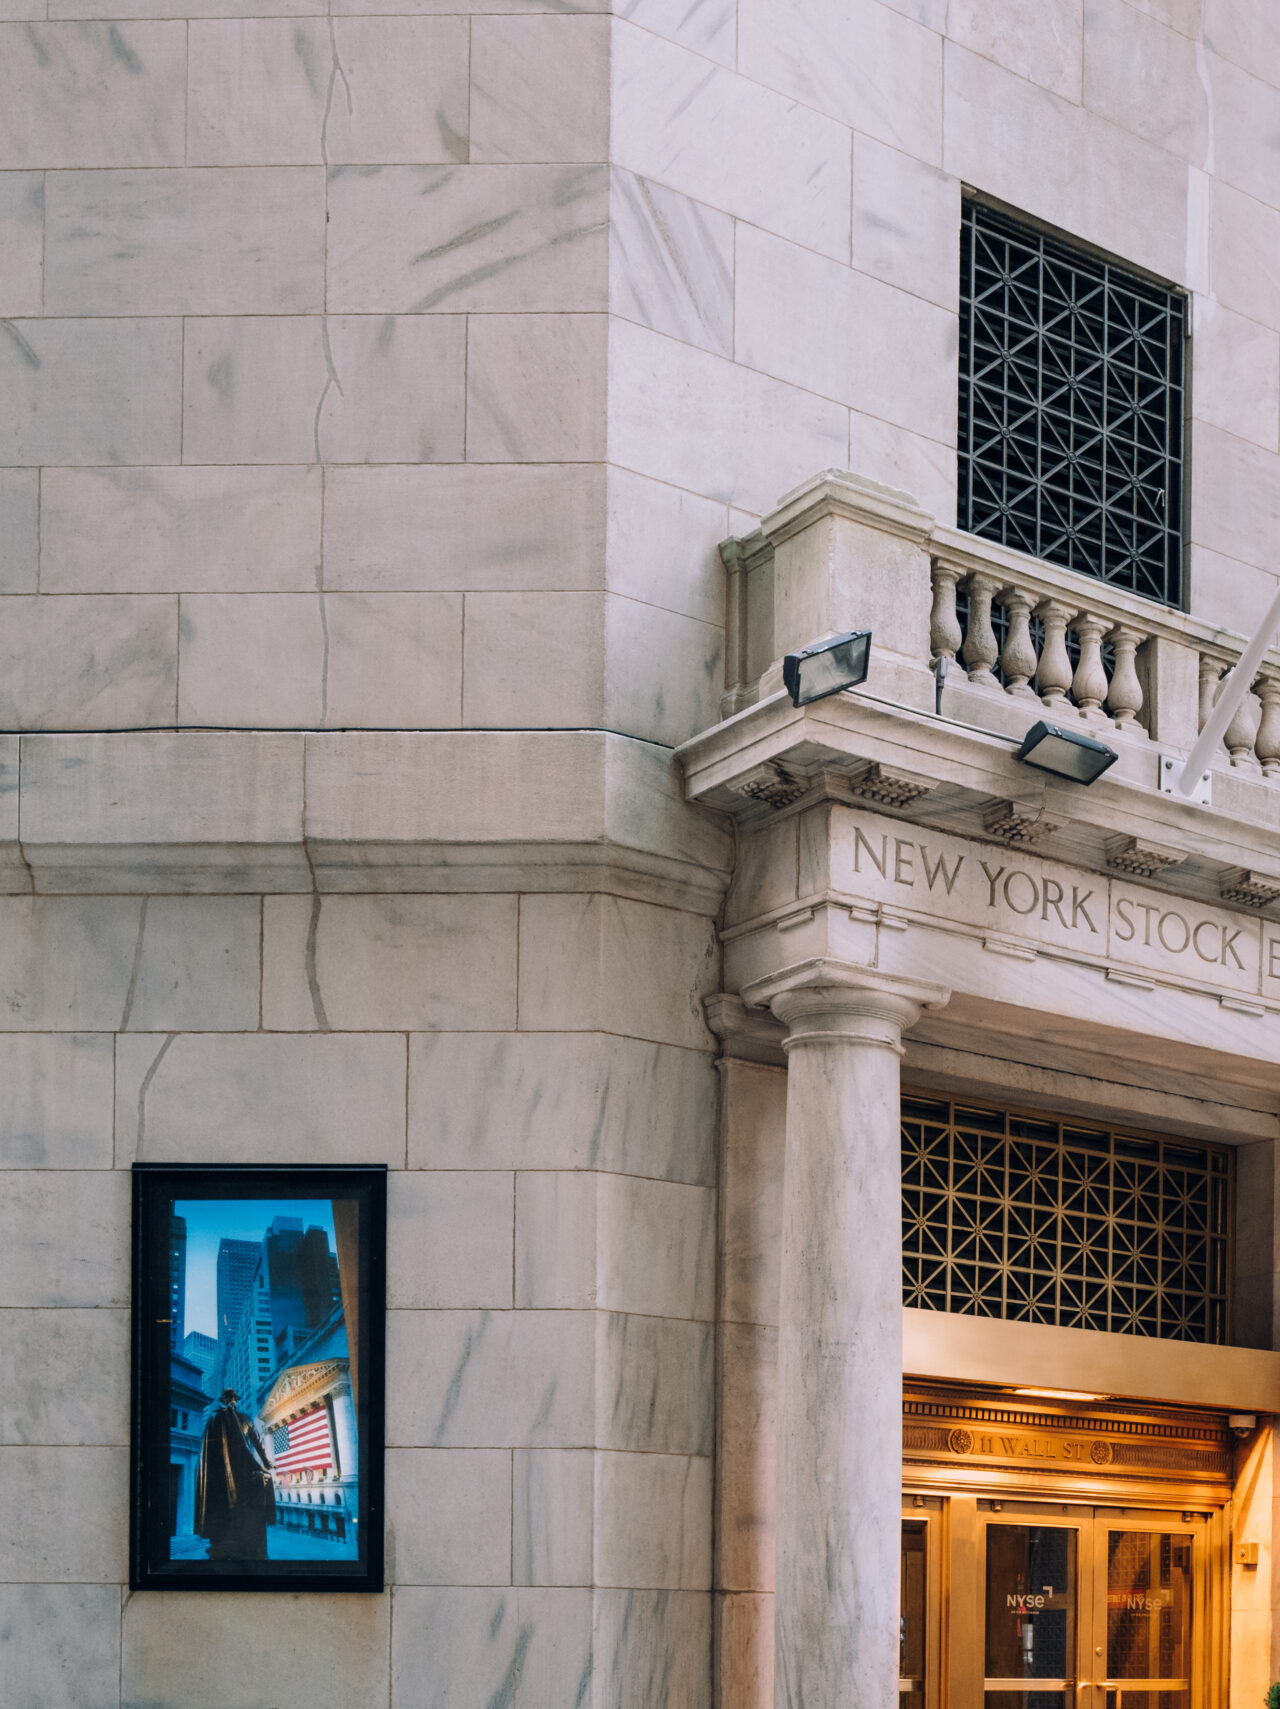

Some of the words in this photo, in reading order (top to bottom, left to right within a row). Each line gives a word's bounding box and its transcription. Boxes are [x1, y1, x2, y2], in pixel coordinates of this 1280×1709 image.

[853, 826, 965, 896] NEW
[977, 859, 1098, 933] YORK
[1114, 898, 1247, 971] STOCK
[980, 1435, 993, 1454] 11
[1000, 1437, 1057, 1459] WALL
[1063, 1441, 1084, 1460] ST
